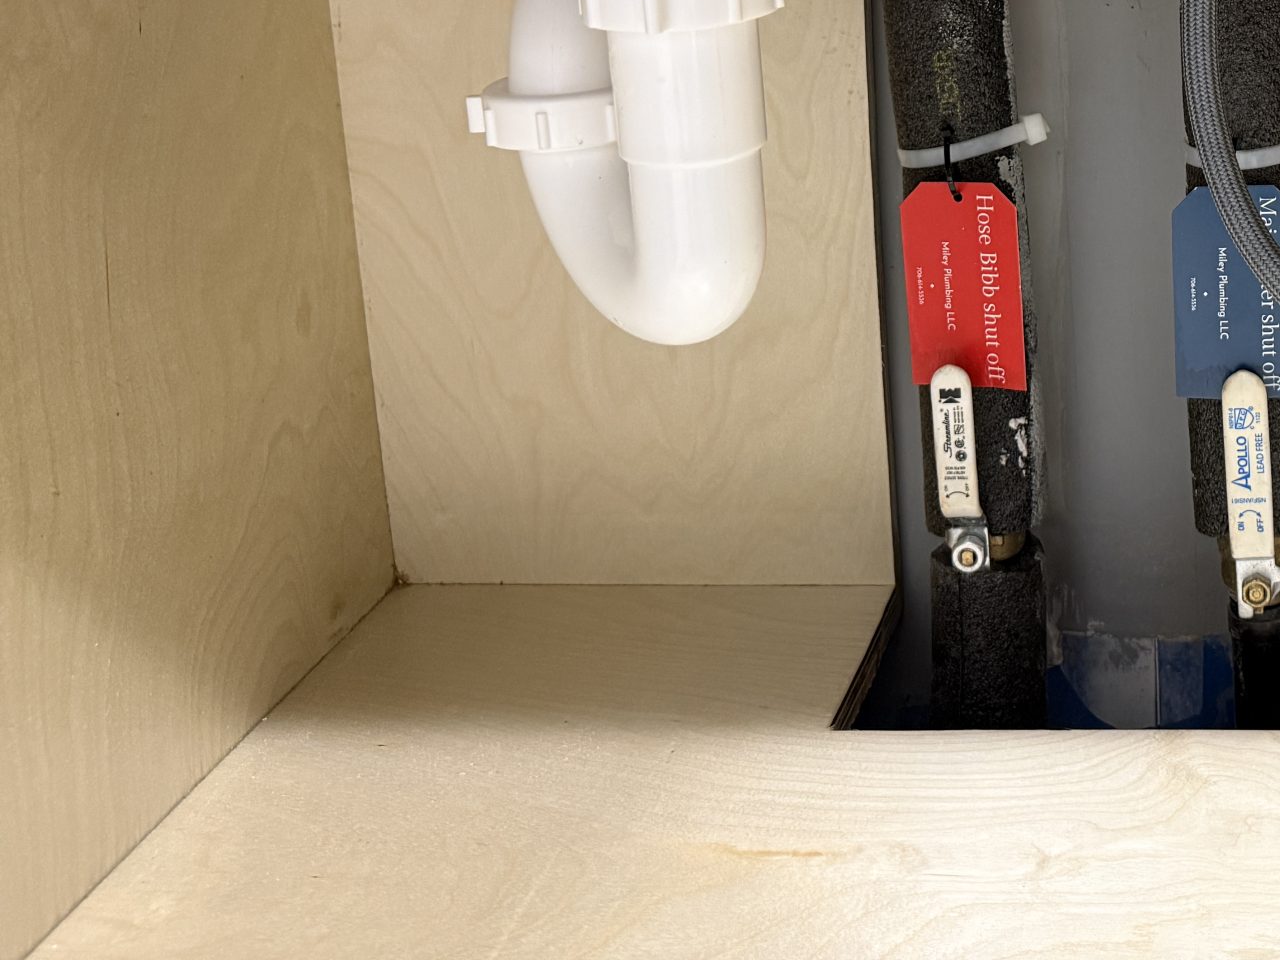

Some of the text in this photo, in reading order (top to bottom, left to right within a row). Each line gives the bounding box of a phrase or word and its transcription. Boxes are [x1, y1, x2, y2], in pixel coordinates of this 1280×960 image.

[940, 241, 956, 331] Miley Plumbing LLC
[976, 194, 1007, 384] Hose Bibb shut off
[1216, 247, 1229, 340] Miley Plumbing LLC
[1261, 314, 1280, 358] shut
[1262, 362, 1280, 392] off
[943, 409, 952, 458] Streamline
[1255, 432, 1264, 474] LEAD FREE
[1231, 436, 1252, 493] APOLLO
[1237, 521, 1245, 531] ON
[1257, 520, 1265, 533] OFF
